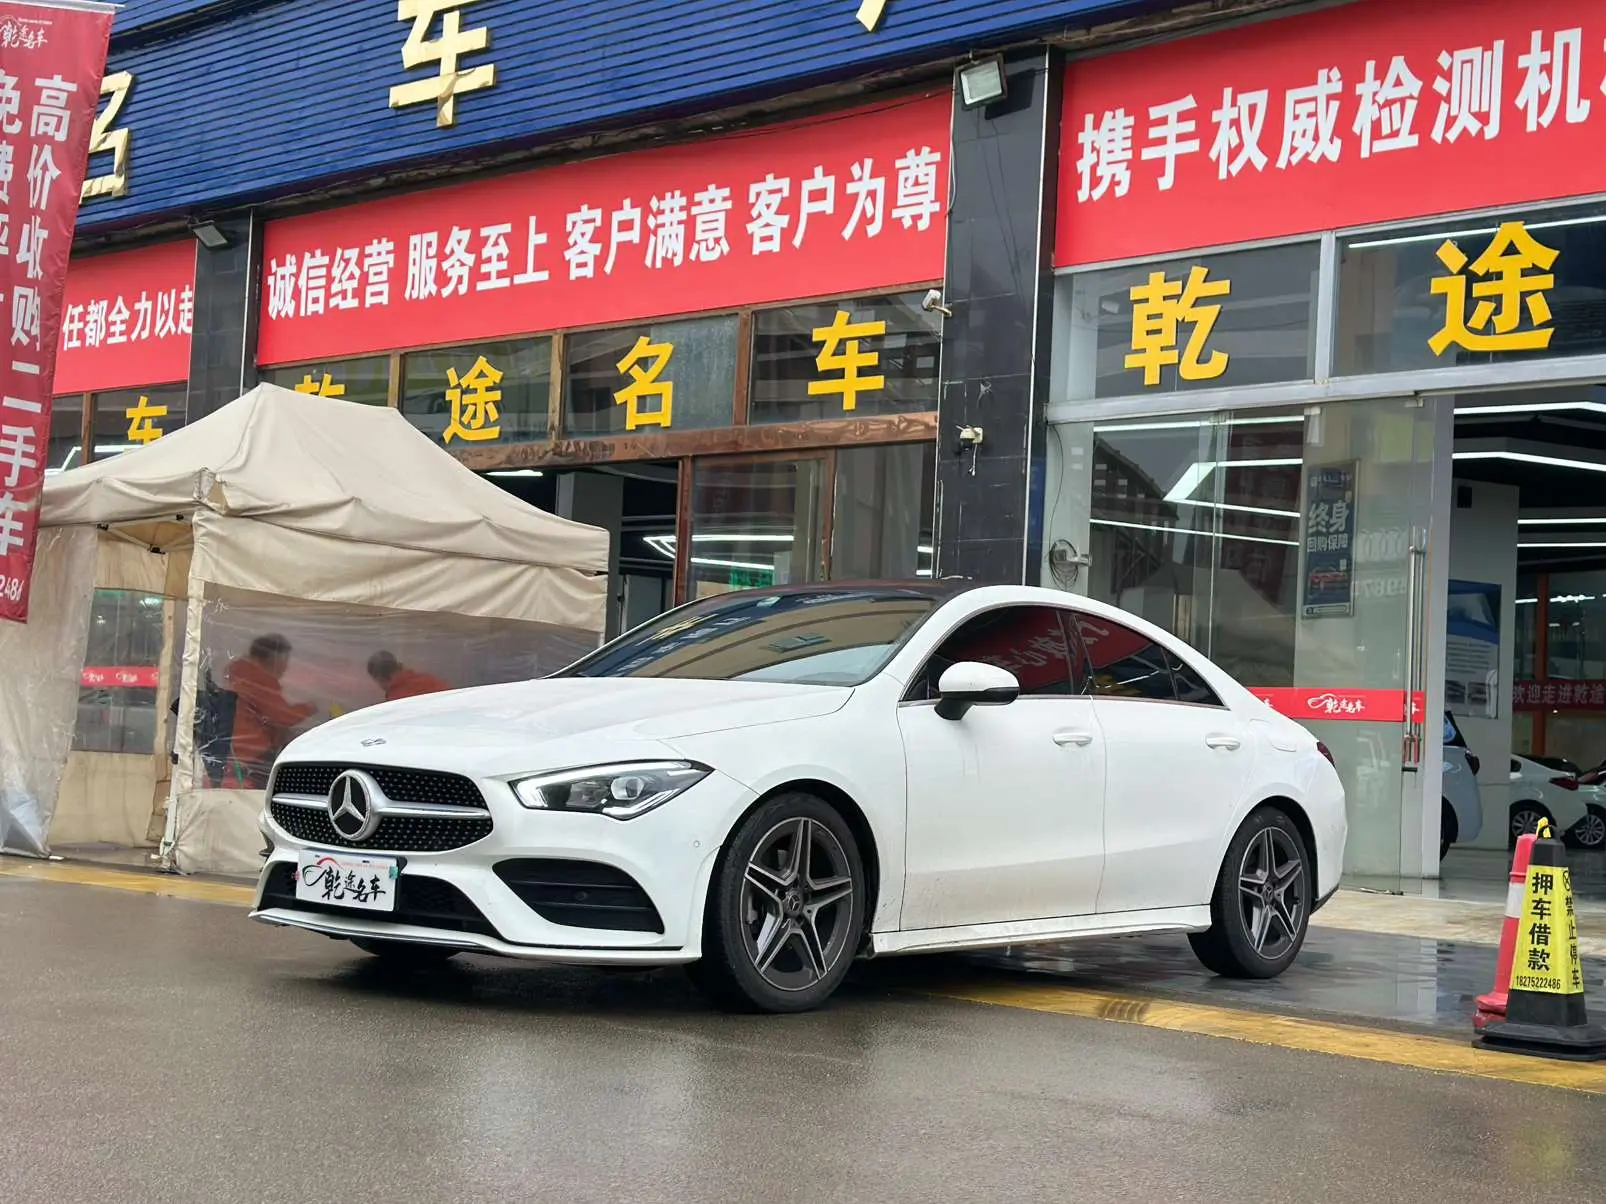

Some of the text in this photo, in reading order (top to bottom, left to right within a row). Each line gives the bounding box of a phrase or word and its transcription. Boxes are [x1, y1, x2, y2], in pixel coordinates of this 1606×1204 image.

[1075, 25, 1606, 204] 携手权威检测机
[266, 145, 943, 321] 诚信经营 服务至上 客户满意 客户为尊
[1123, 220, 1561, 386] 乾 途
[442, 310, 888, 445] 途 名 车
[1515, 975, 1561, 990] 18275222486
[1527, 872, 1554, 971] 押车借款
[1564, 895, 1580, 989] 禁止停车
